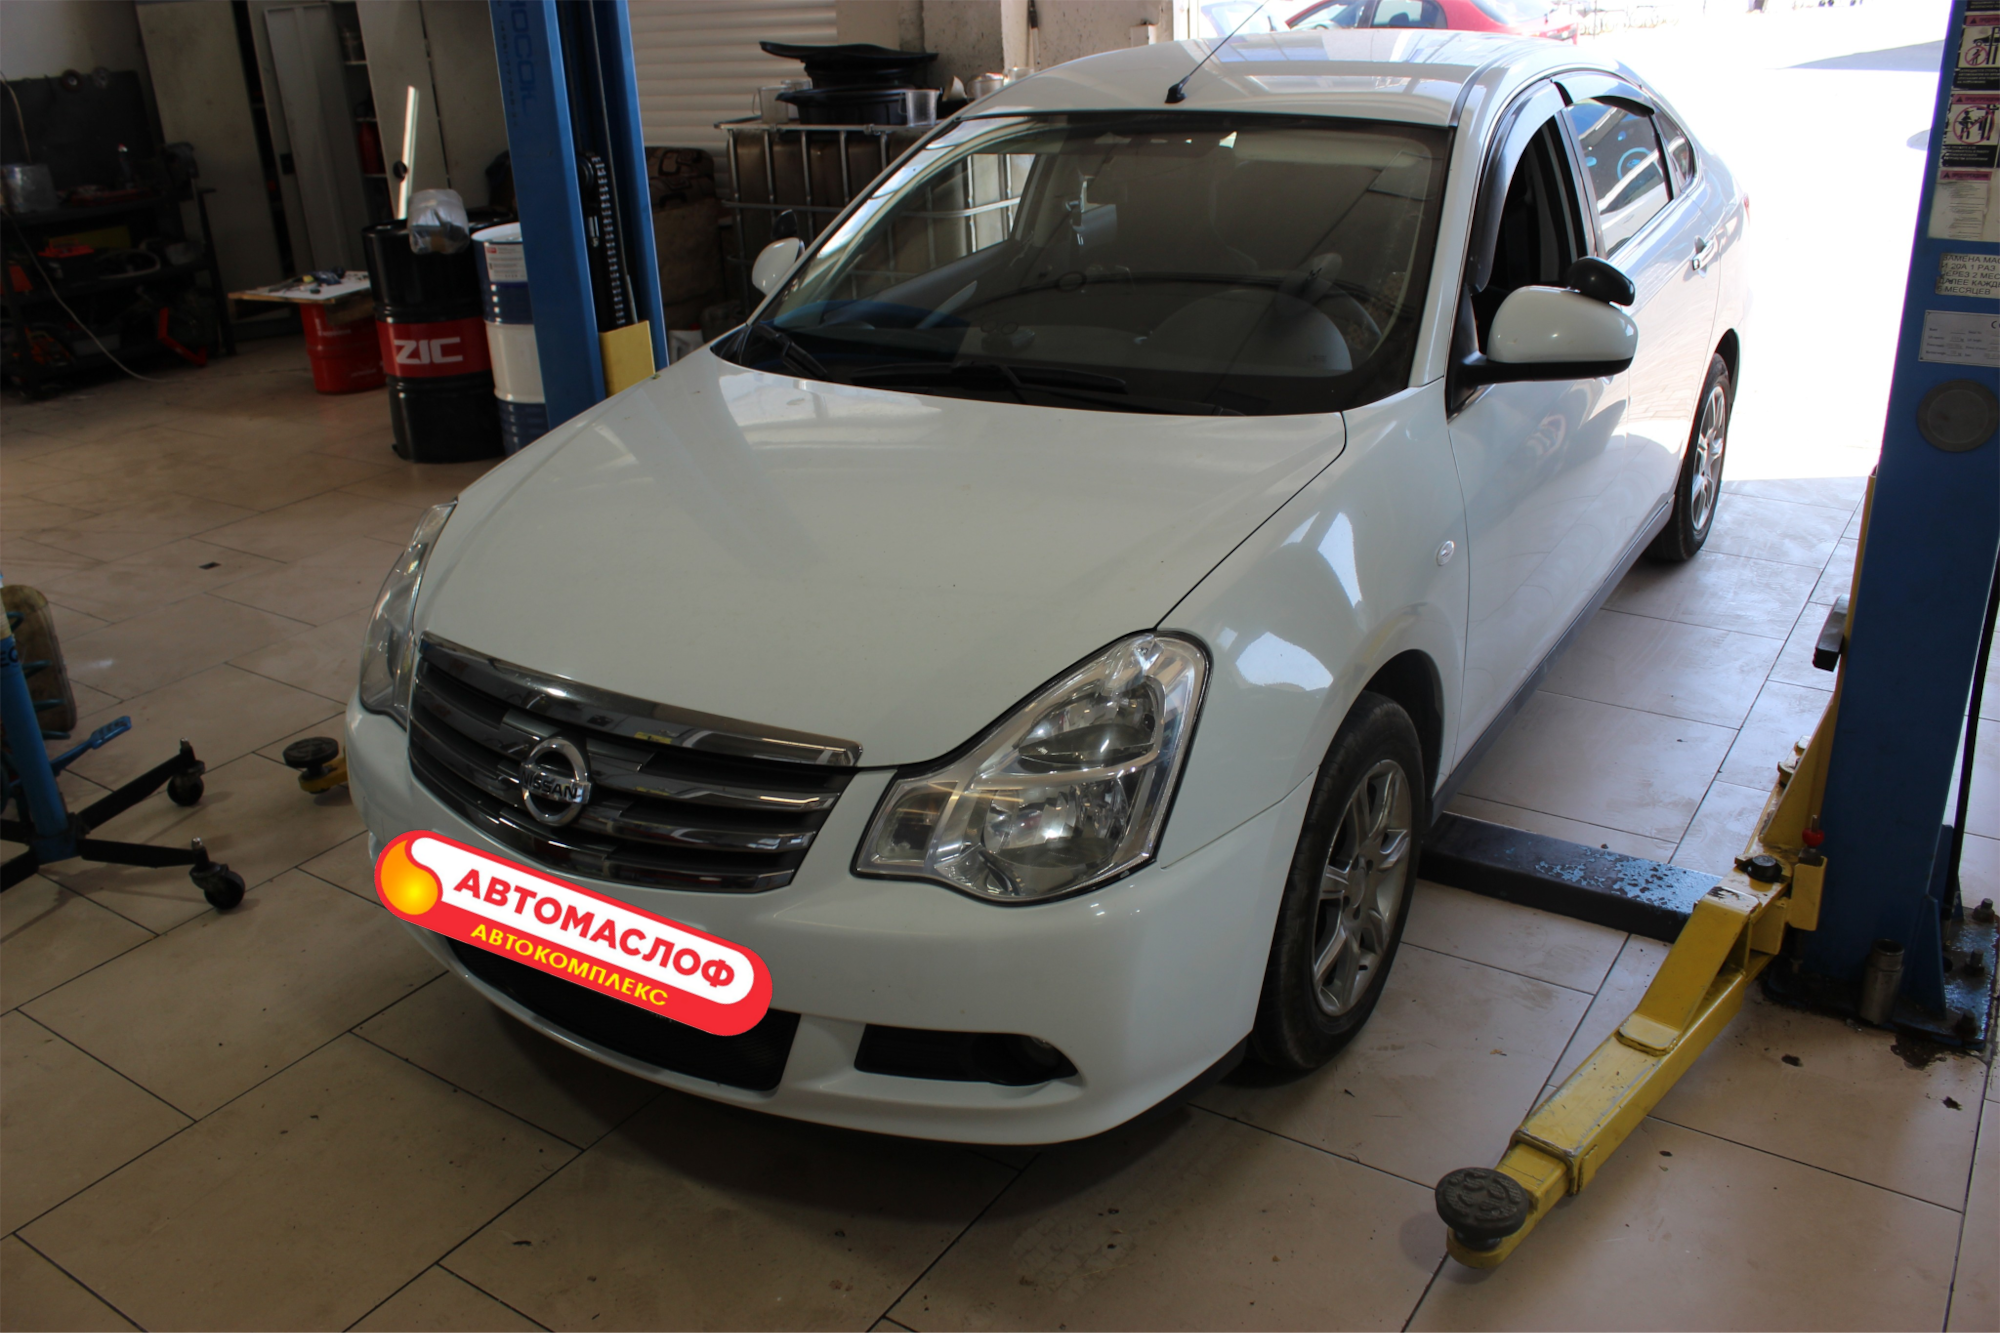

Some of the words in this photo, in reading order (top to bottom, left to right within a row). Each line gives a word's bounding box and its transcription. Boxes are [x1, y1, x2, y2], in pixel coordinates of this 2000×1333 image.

[1943, 255, 1980, 263] ЗАМЕНА
[1943, 270, 1970, 278] ЕРЕЗ
[1944, 286, 1991, 295] МЕСЯЦЕВ
[393, 336, 464, 365] ZIC
[521, 770, 578, 799] NISSAN
